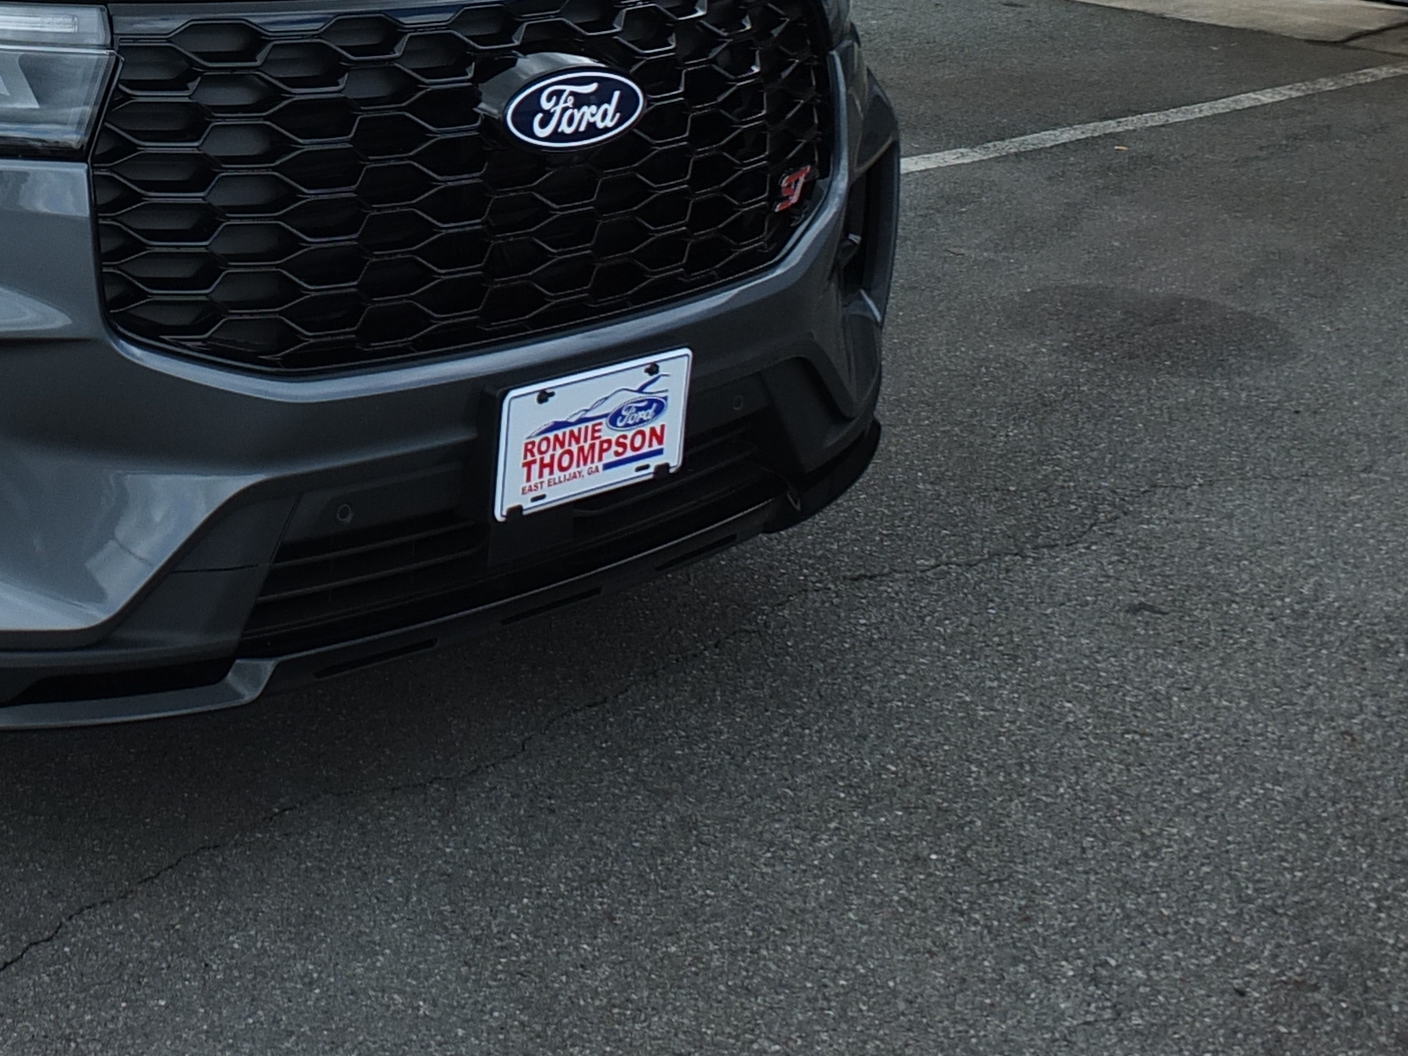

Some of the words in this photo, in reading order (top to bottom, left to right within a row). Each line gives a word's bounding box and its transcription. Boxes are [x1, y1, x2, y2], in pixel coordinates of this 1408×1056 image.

[533, 82, 621, 138] Ford
[617, 400, 656, 426] Ford
[521, 425, 666, 483] THOMPSON
[523, 421, 603, 461] RONNIE
[521, 480, 544, 495] EAST
[586, 465, 600, 476] GA
